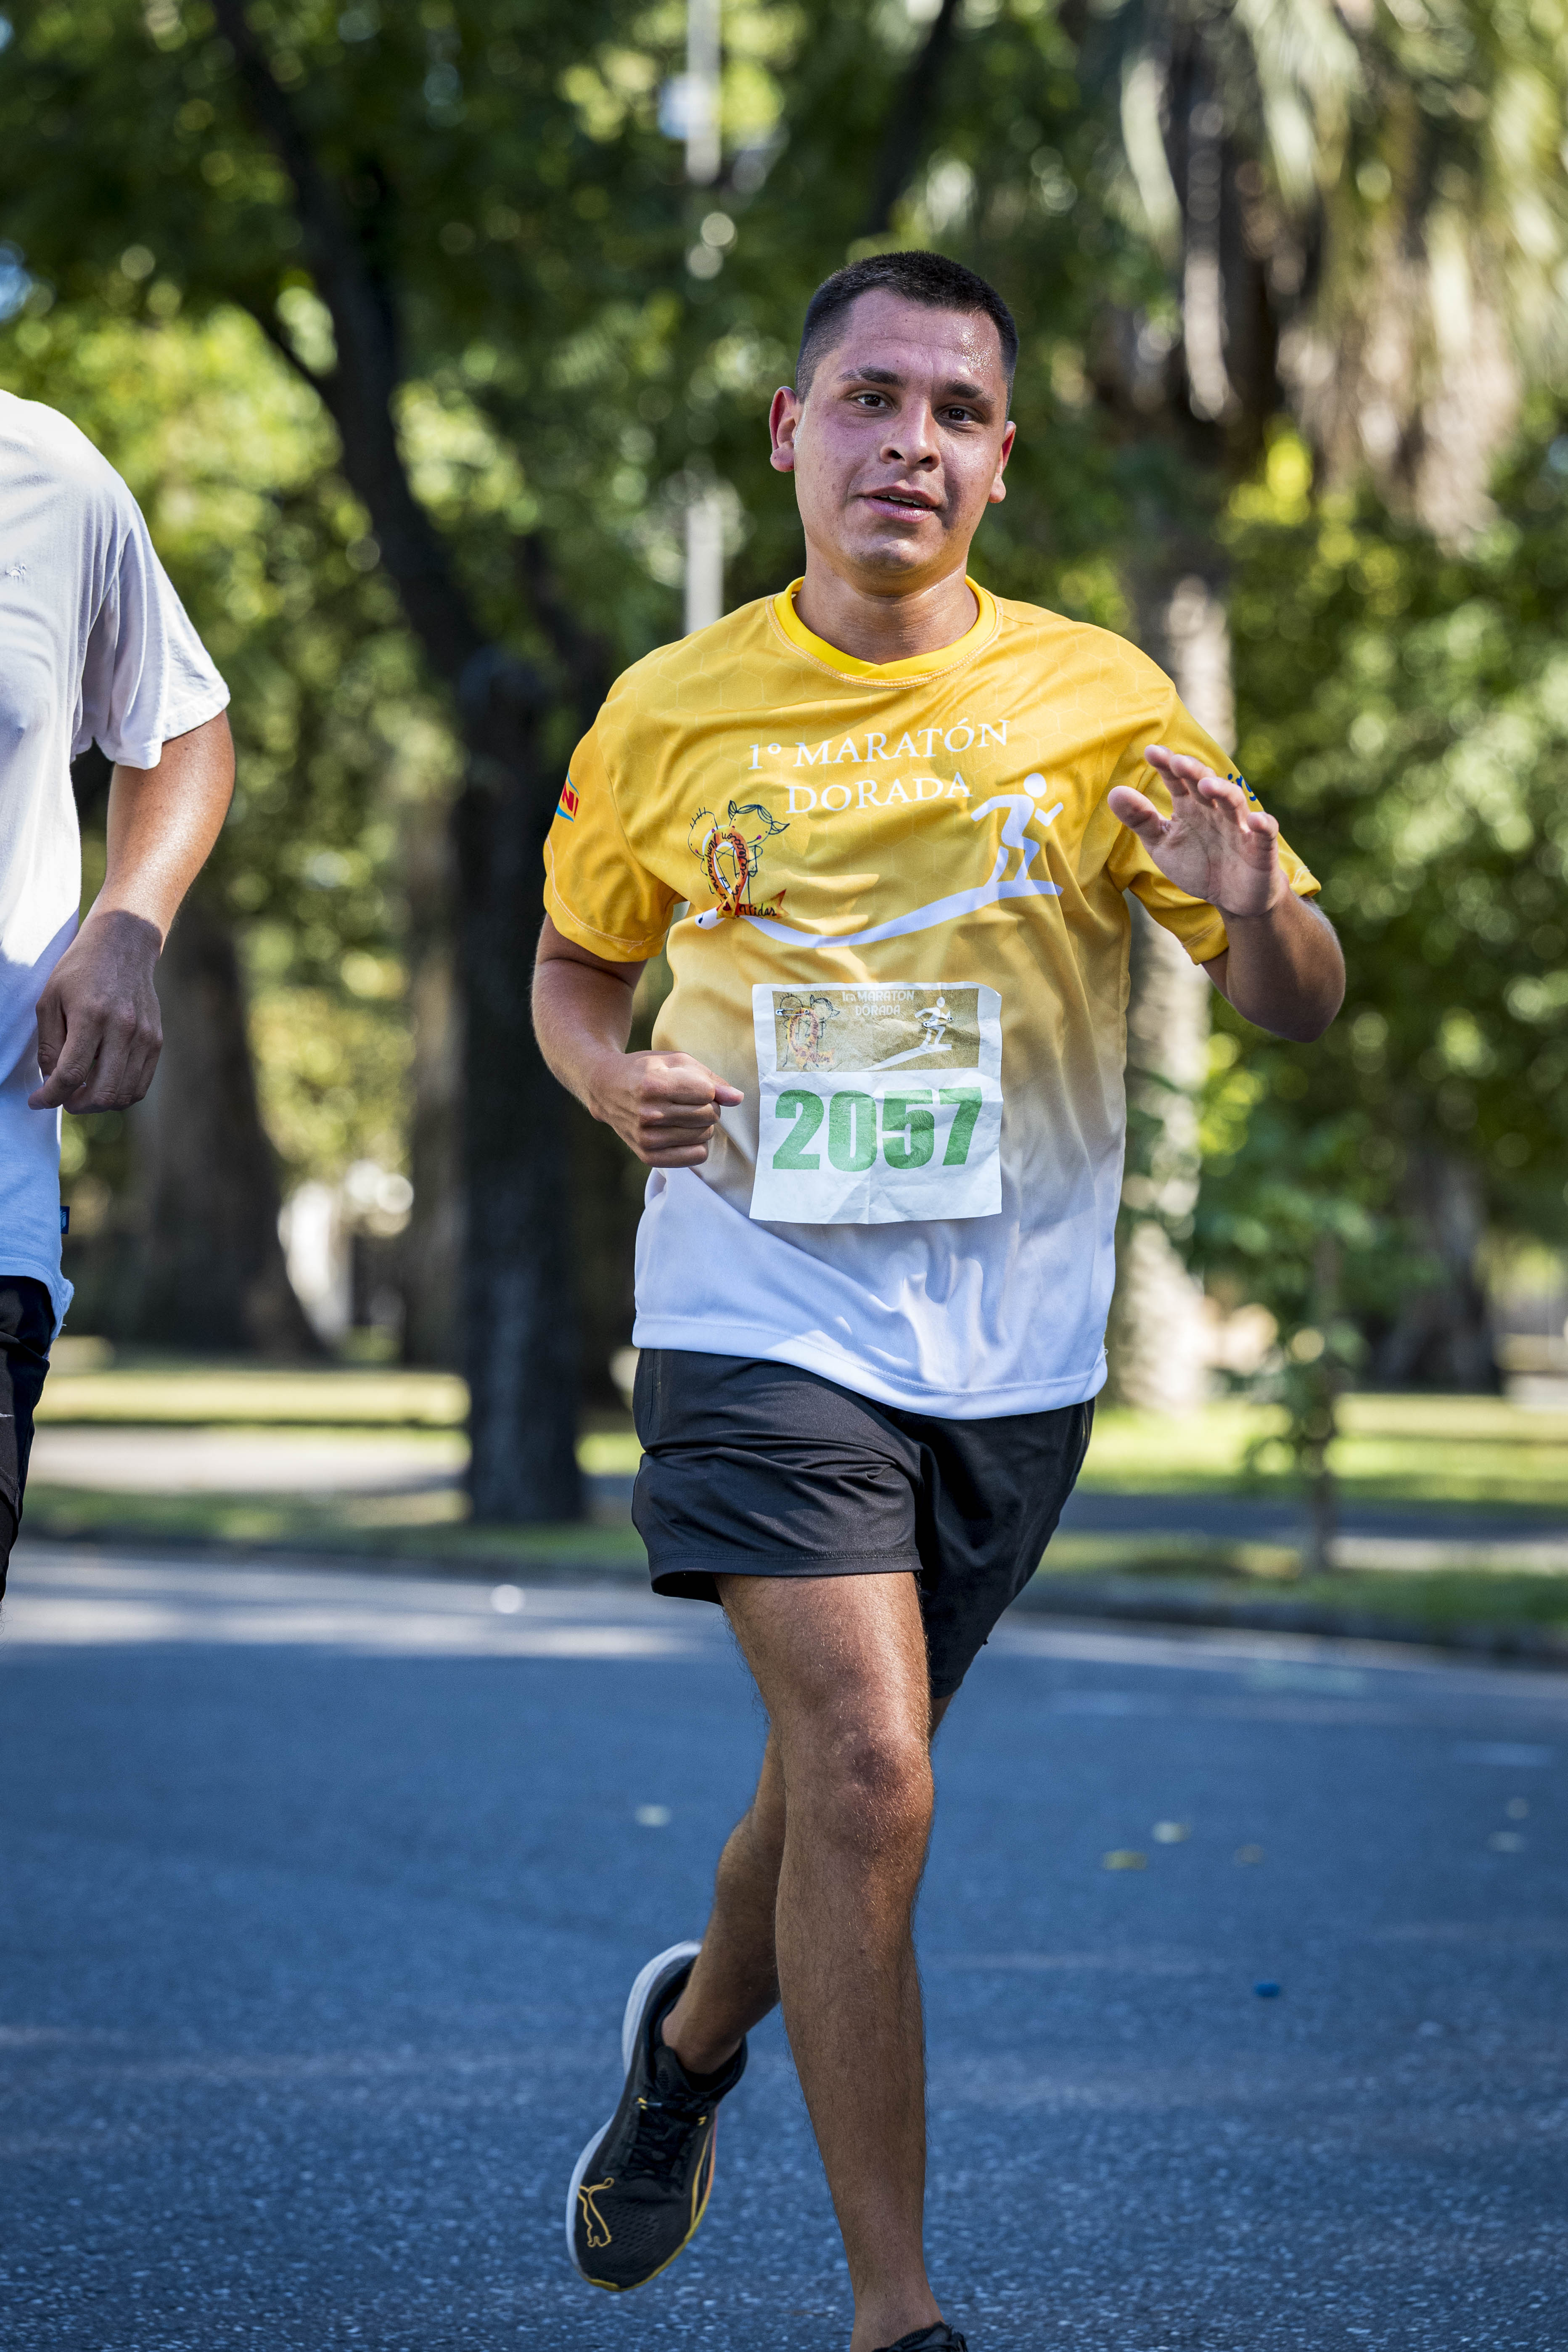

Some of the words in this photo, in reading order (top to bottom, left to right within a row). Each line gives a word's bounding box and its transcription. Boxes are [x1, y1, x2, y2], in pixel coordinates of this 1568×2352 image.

[793, 718, 1010, 767] MARATÓN
[785, 772, 973, 814] DORADA
[856, 1005, 900, 1016] DORADA
[772, 1087, 982, 1172] 2057
